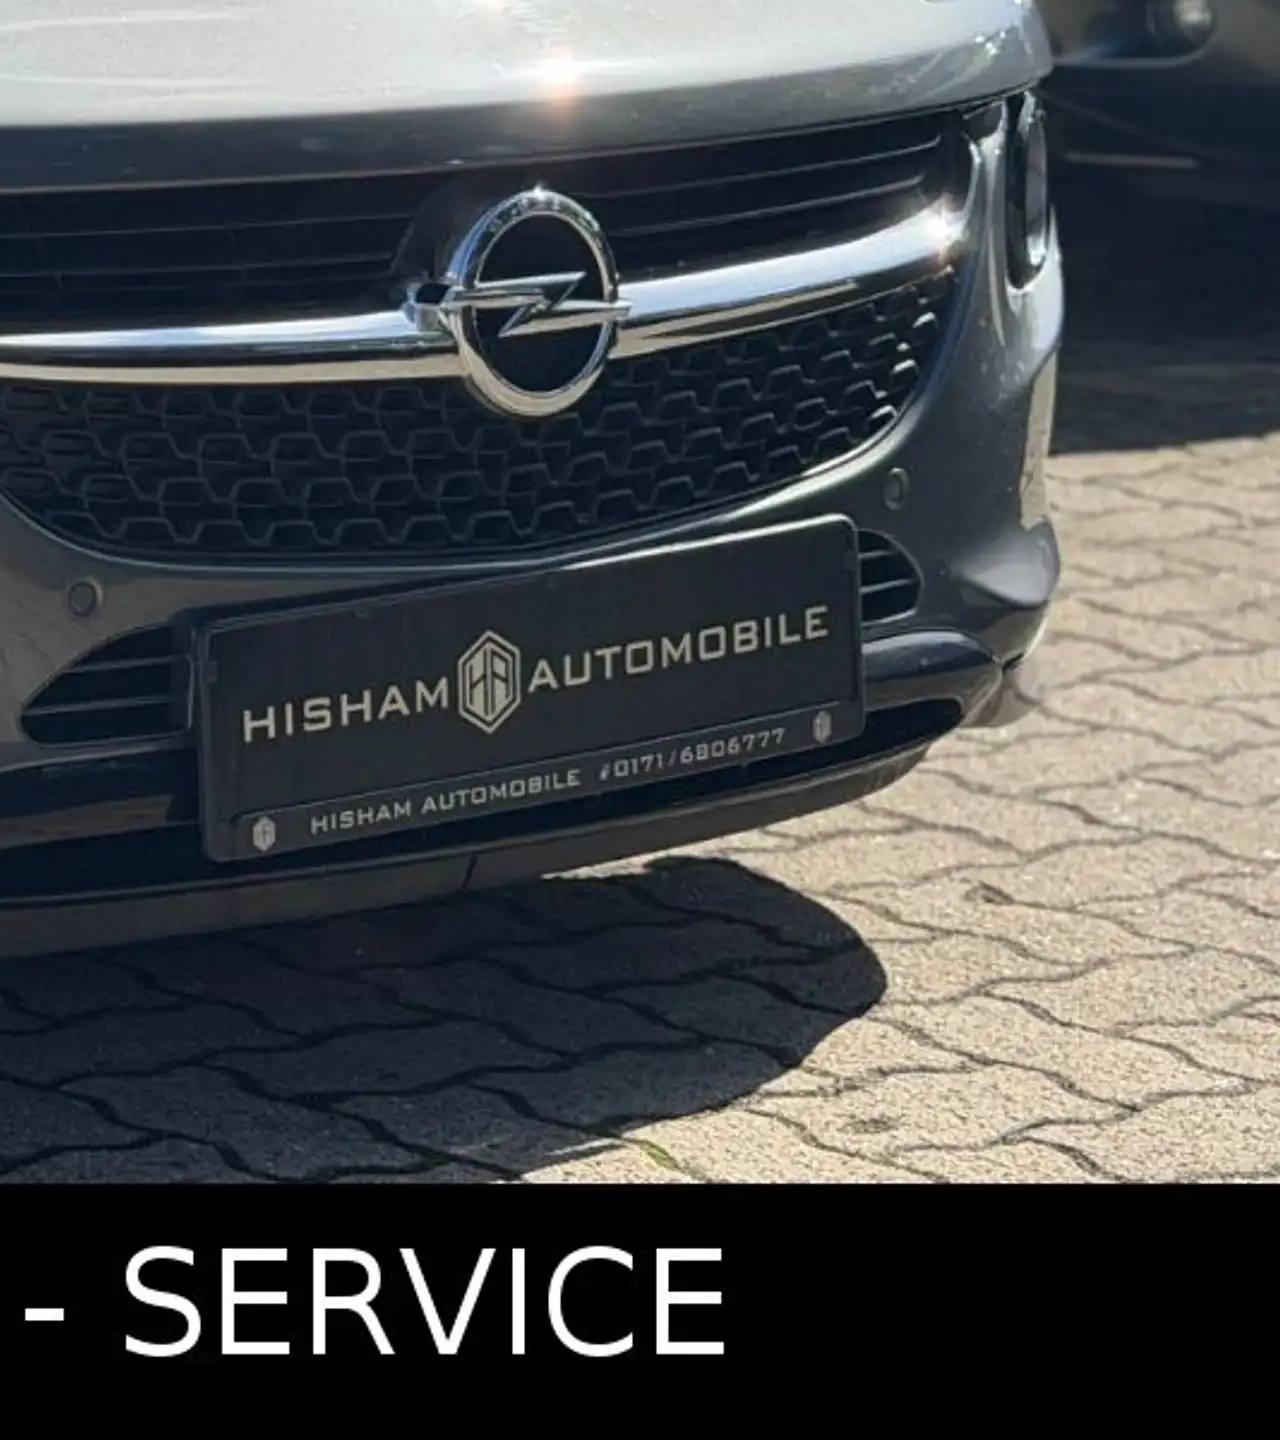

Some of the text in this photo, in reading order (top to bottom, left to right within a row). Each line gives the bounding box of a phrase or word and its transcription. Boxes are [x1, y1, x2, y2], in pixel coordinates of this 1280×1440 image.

[243, 676, 449, 743] HISHAM
[528, 606, 829, 693] AUTOMOBILE
[310, 800, 411, 835] HISHAM
[420, 768, 581, 815] AUTOMOBILE
